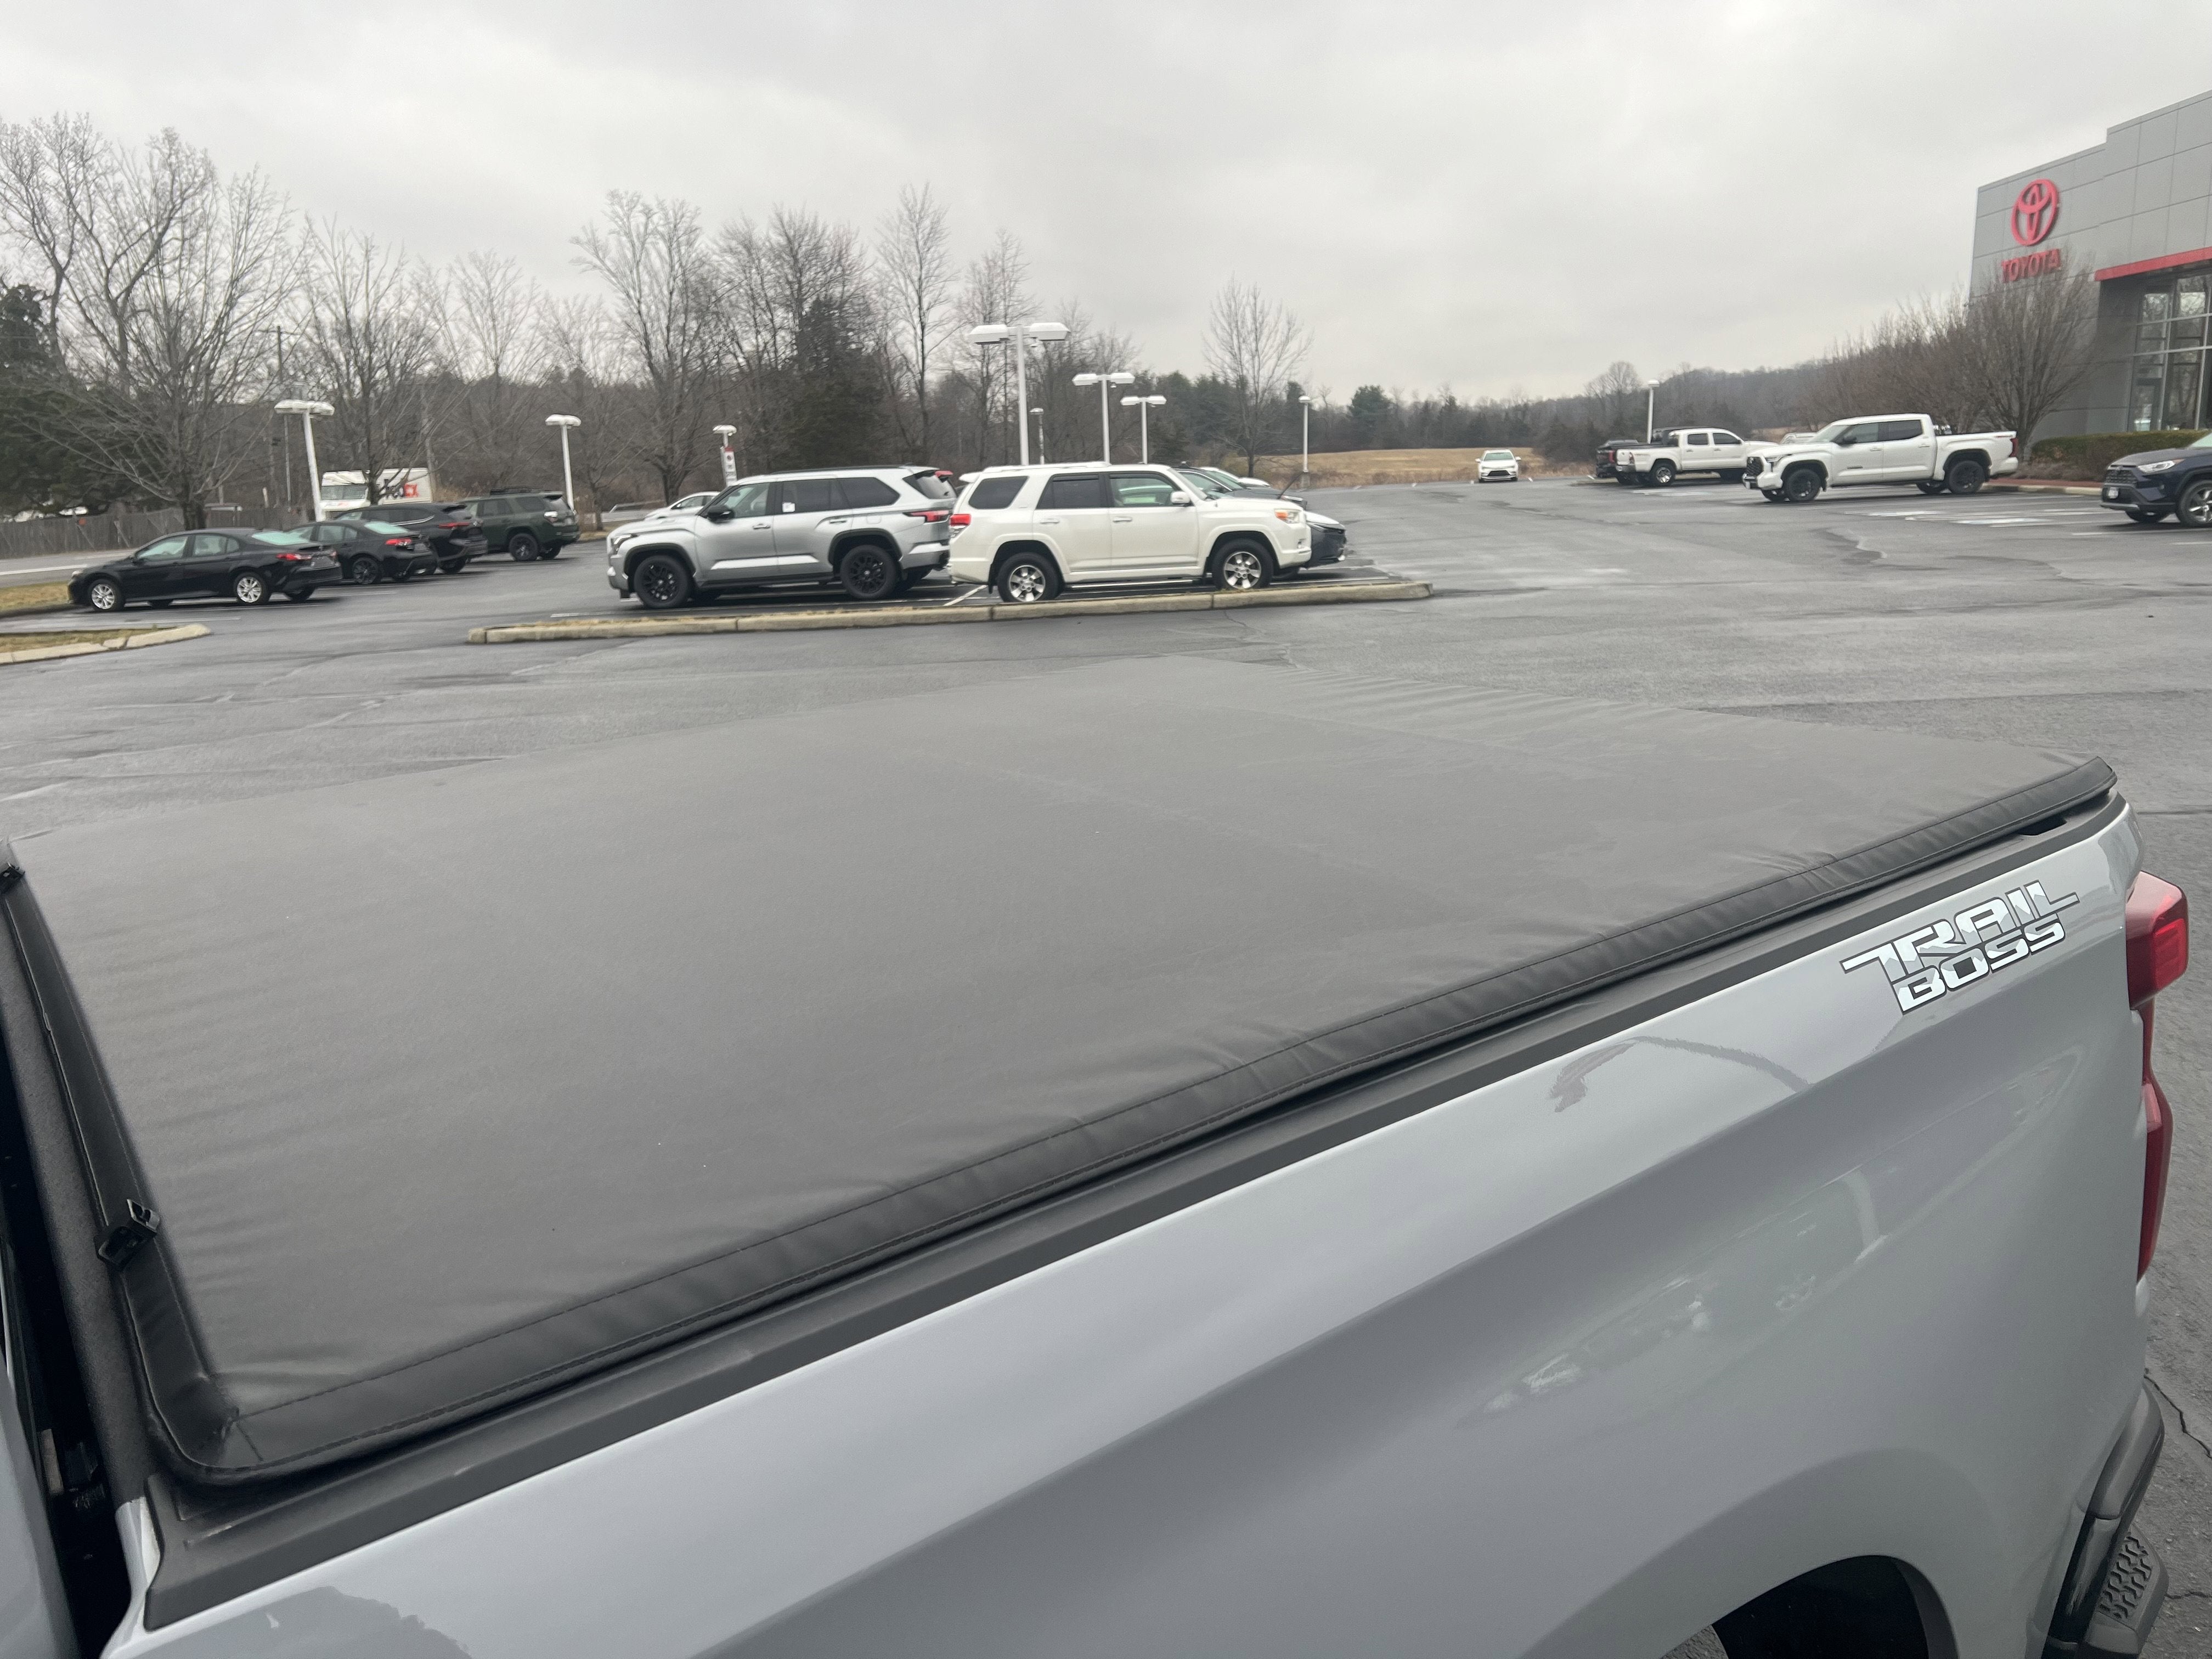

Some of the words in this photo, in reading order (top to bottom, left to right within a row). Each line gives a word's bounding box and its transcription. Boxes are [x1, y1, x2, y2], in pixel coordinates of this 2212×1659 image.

[2001, 249, 2061, 283] TOYOTA
[1839, 879, 2080, 985] TRAIL
[1892, 913, 2066, 1015] BOSS
